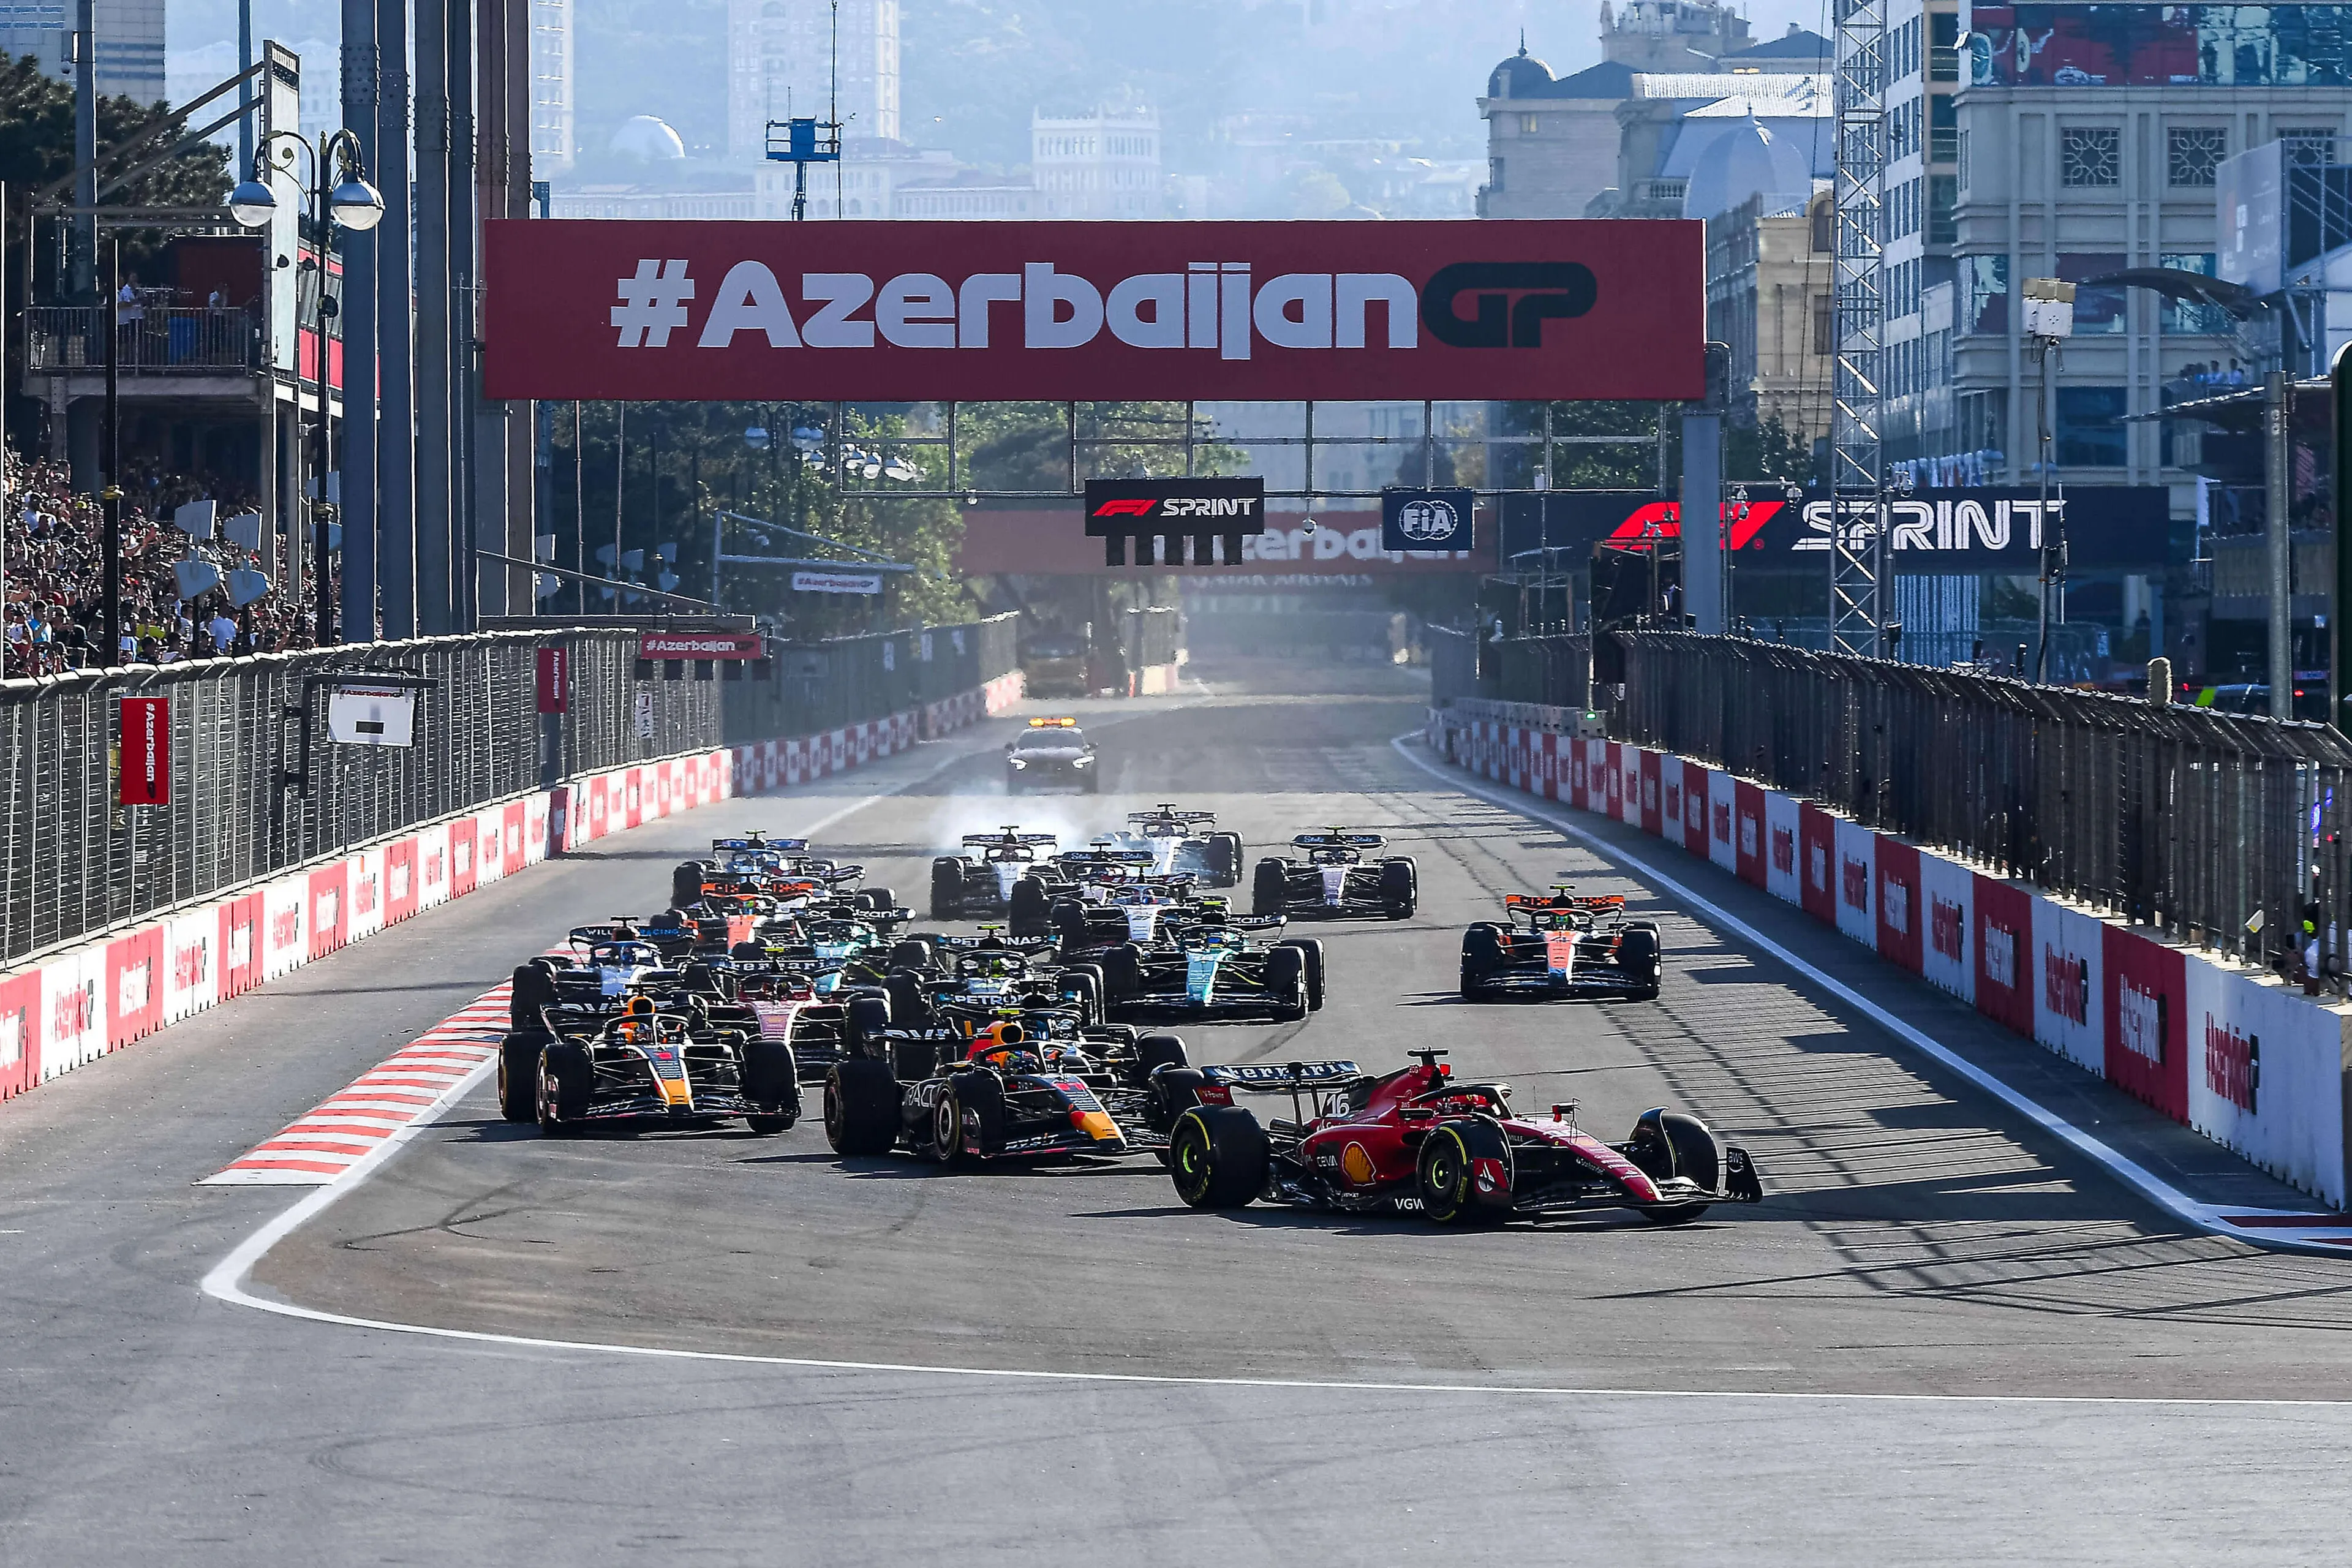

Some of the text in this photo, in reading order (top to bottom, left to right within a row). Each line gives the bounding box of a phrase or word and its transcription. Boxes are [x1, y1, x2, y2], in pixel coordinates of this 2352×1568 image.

[1160, 498, 1257, 516] SPRINT
[1792, 500, 2068, 550] SPRINT
[1324, 1093, 1349, 1117] 16
